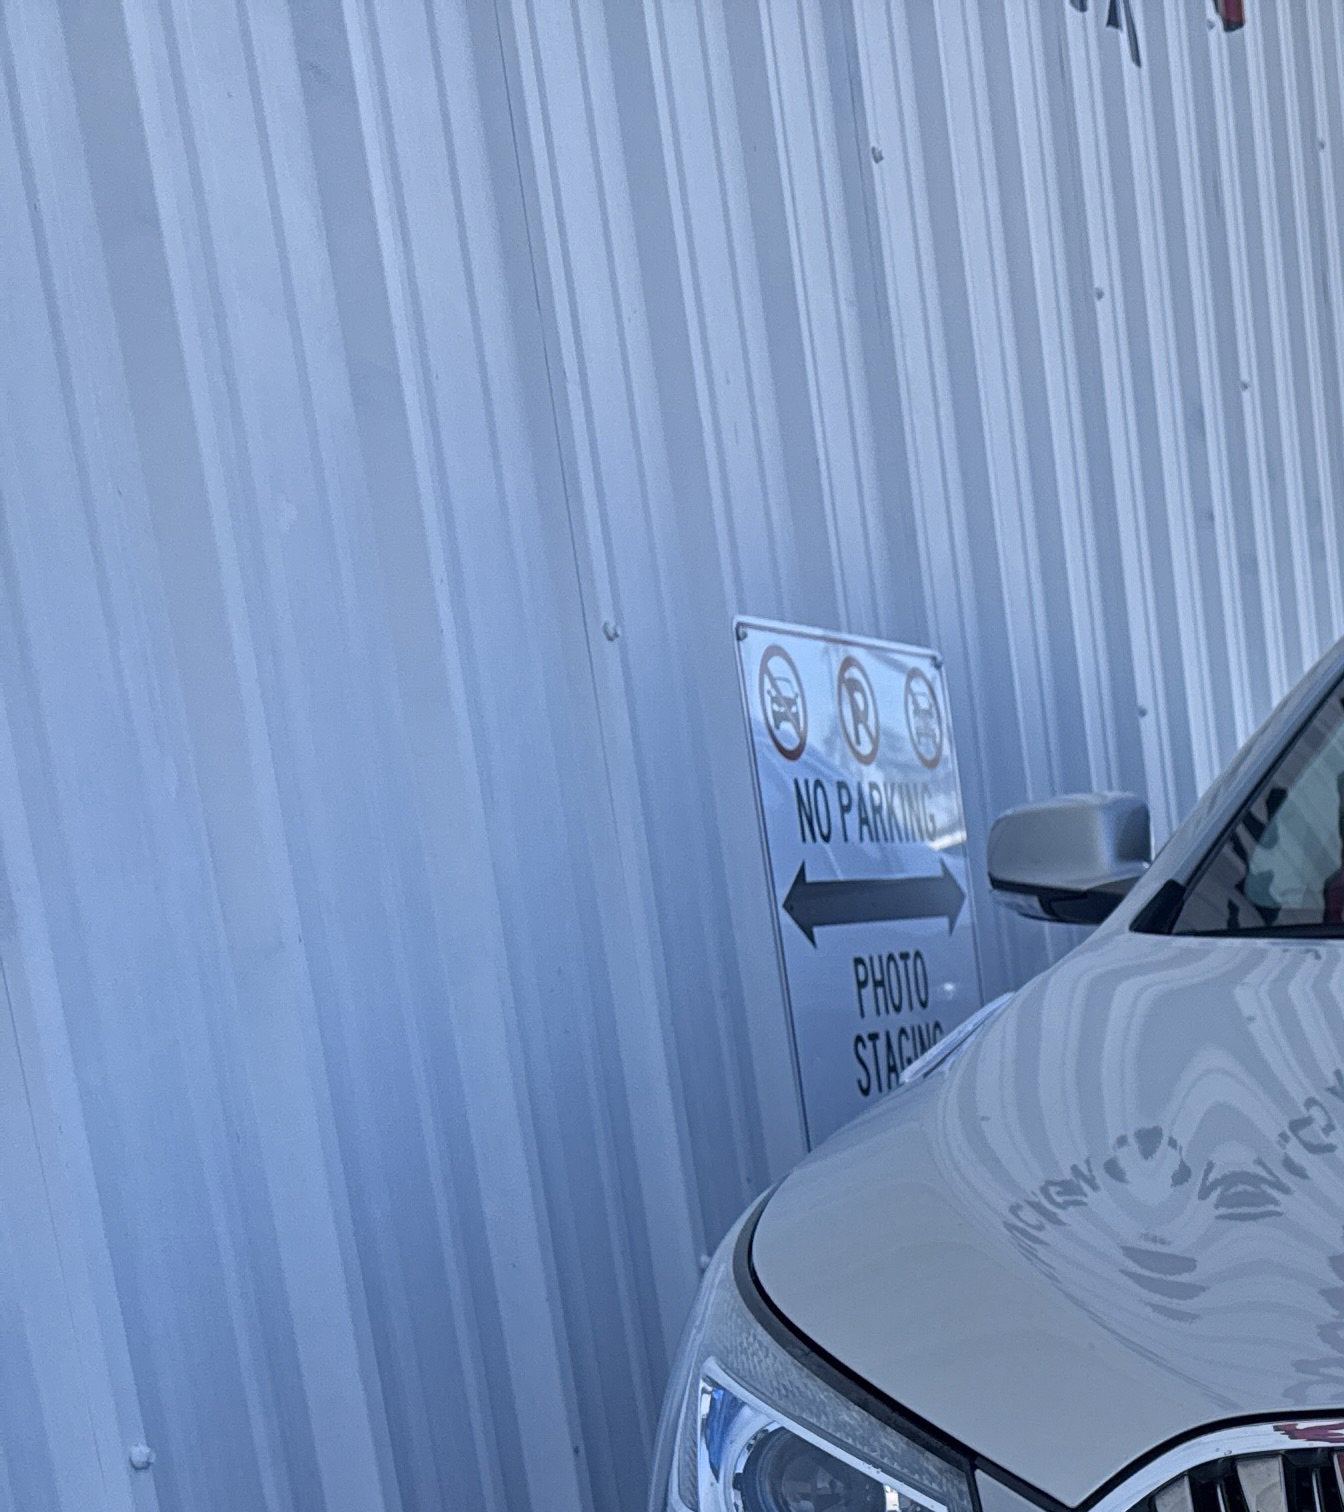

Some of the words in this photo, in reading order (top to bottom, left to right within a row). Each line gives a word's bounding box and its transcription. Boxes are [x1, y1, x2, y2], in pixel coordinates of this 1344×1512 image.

[793, 777, 832, 844] NO
[836, 780, 937, 843] PARKING
[853, 950, 930, 1020] PHOTO
